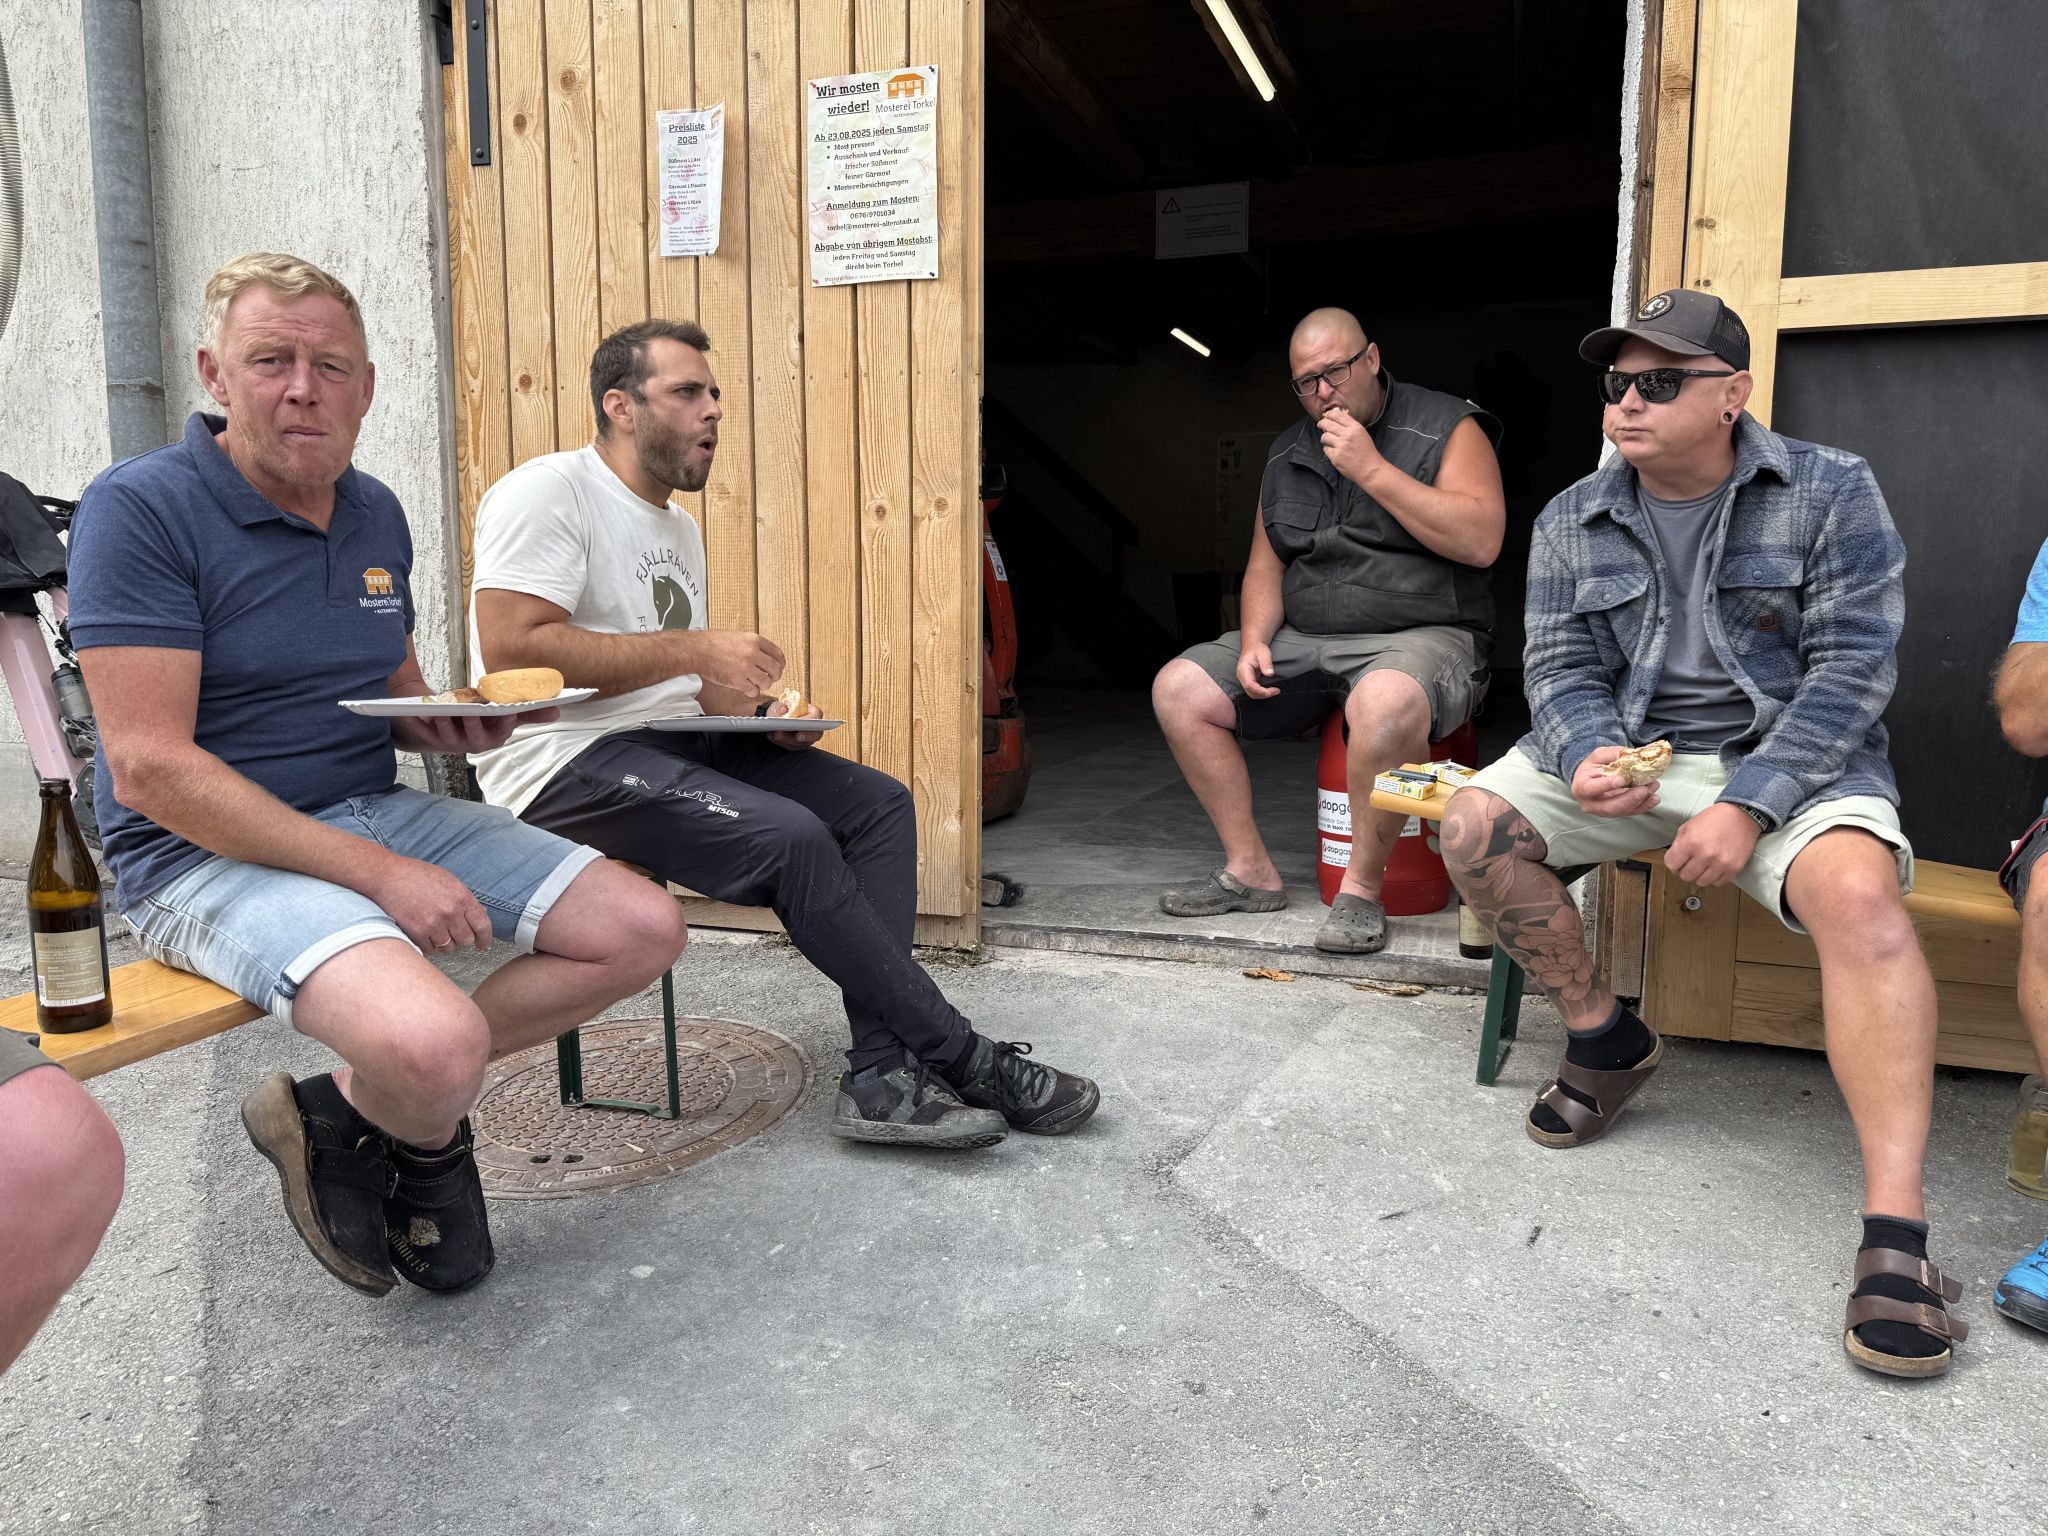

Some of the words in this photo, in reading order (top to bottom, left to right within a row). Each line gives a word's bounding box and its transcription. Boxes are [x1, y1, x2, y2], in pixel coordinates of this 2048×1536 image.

[816, 84, 837, 97] Wir
[839, 81, 880, 95] mosten
[827, 99, 870, 115] wieder!
[875, 102, 911, 114] Mosterei
[911, 97, 936, 109] Torkel
[668, 122, 706, 133] Preisliste
[814, 133, 826, 141] Ab
[827, 128, 872, 141] 23.08.2025
[872, 126, 895, 138] jeden
[677, 135, 698, 145] 2025
[834, 143, 850, 151] Most
[850, 141, 875, 151] pressen
[869, 149, 881, 157] und
[834, 179, 909, 192] Mostereibesichtigungen
[826, 199, 871, 211] Anmeldung
[872, 198, 889, 207] zum
[890, 194, 920, 205] Mosten:
[814, 241, 844, 253] Abgabe
[845, 241, 861, 250] von
[862, 238, 895, 249] übrigem
[832, 253, 850, 262] jeden
[851, 251, 875, 261] Freitag
[876, 250, 889, 259] und
[889, 249, 916, 259] Samstag
[865, 261, 882, 270] beim
[635, 547, 699, 597] FJÄLLRÄVEN
[706, 804, 740, 818] MT500
